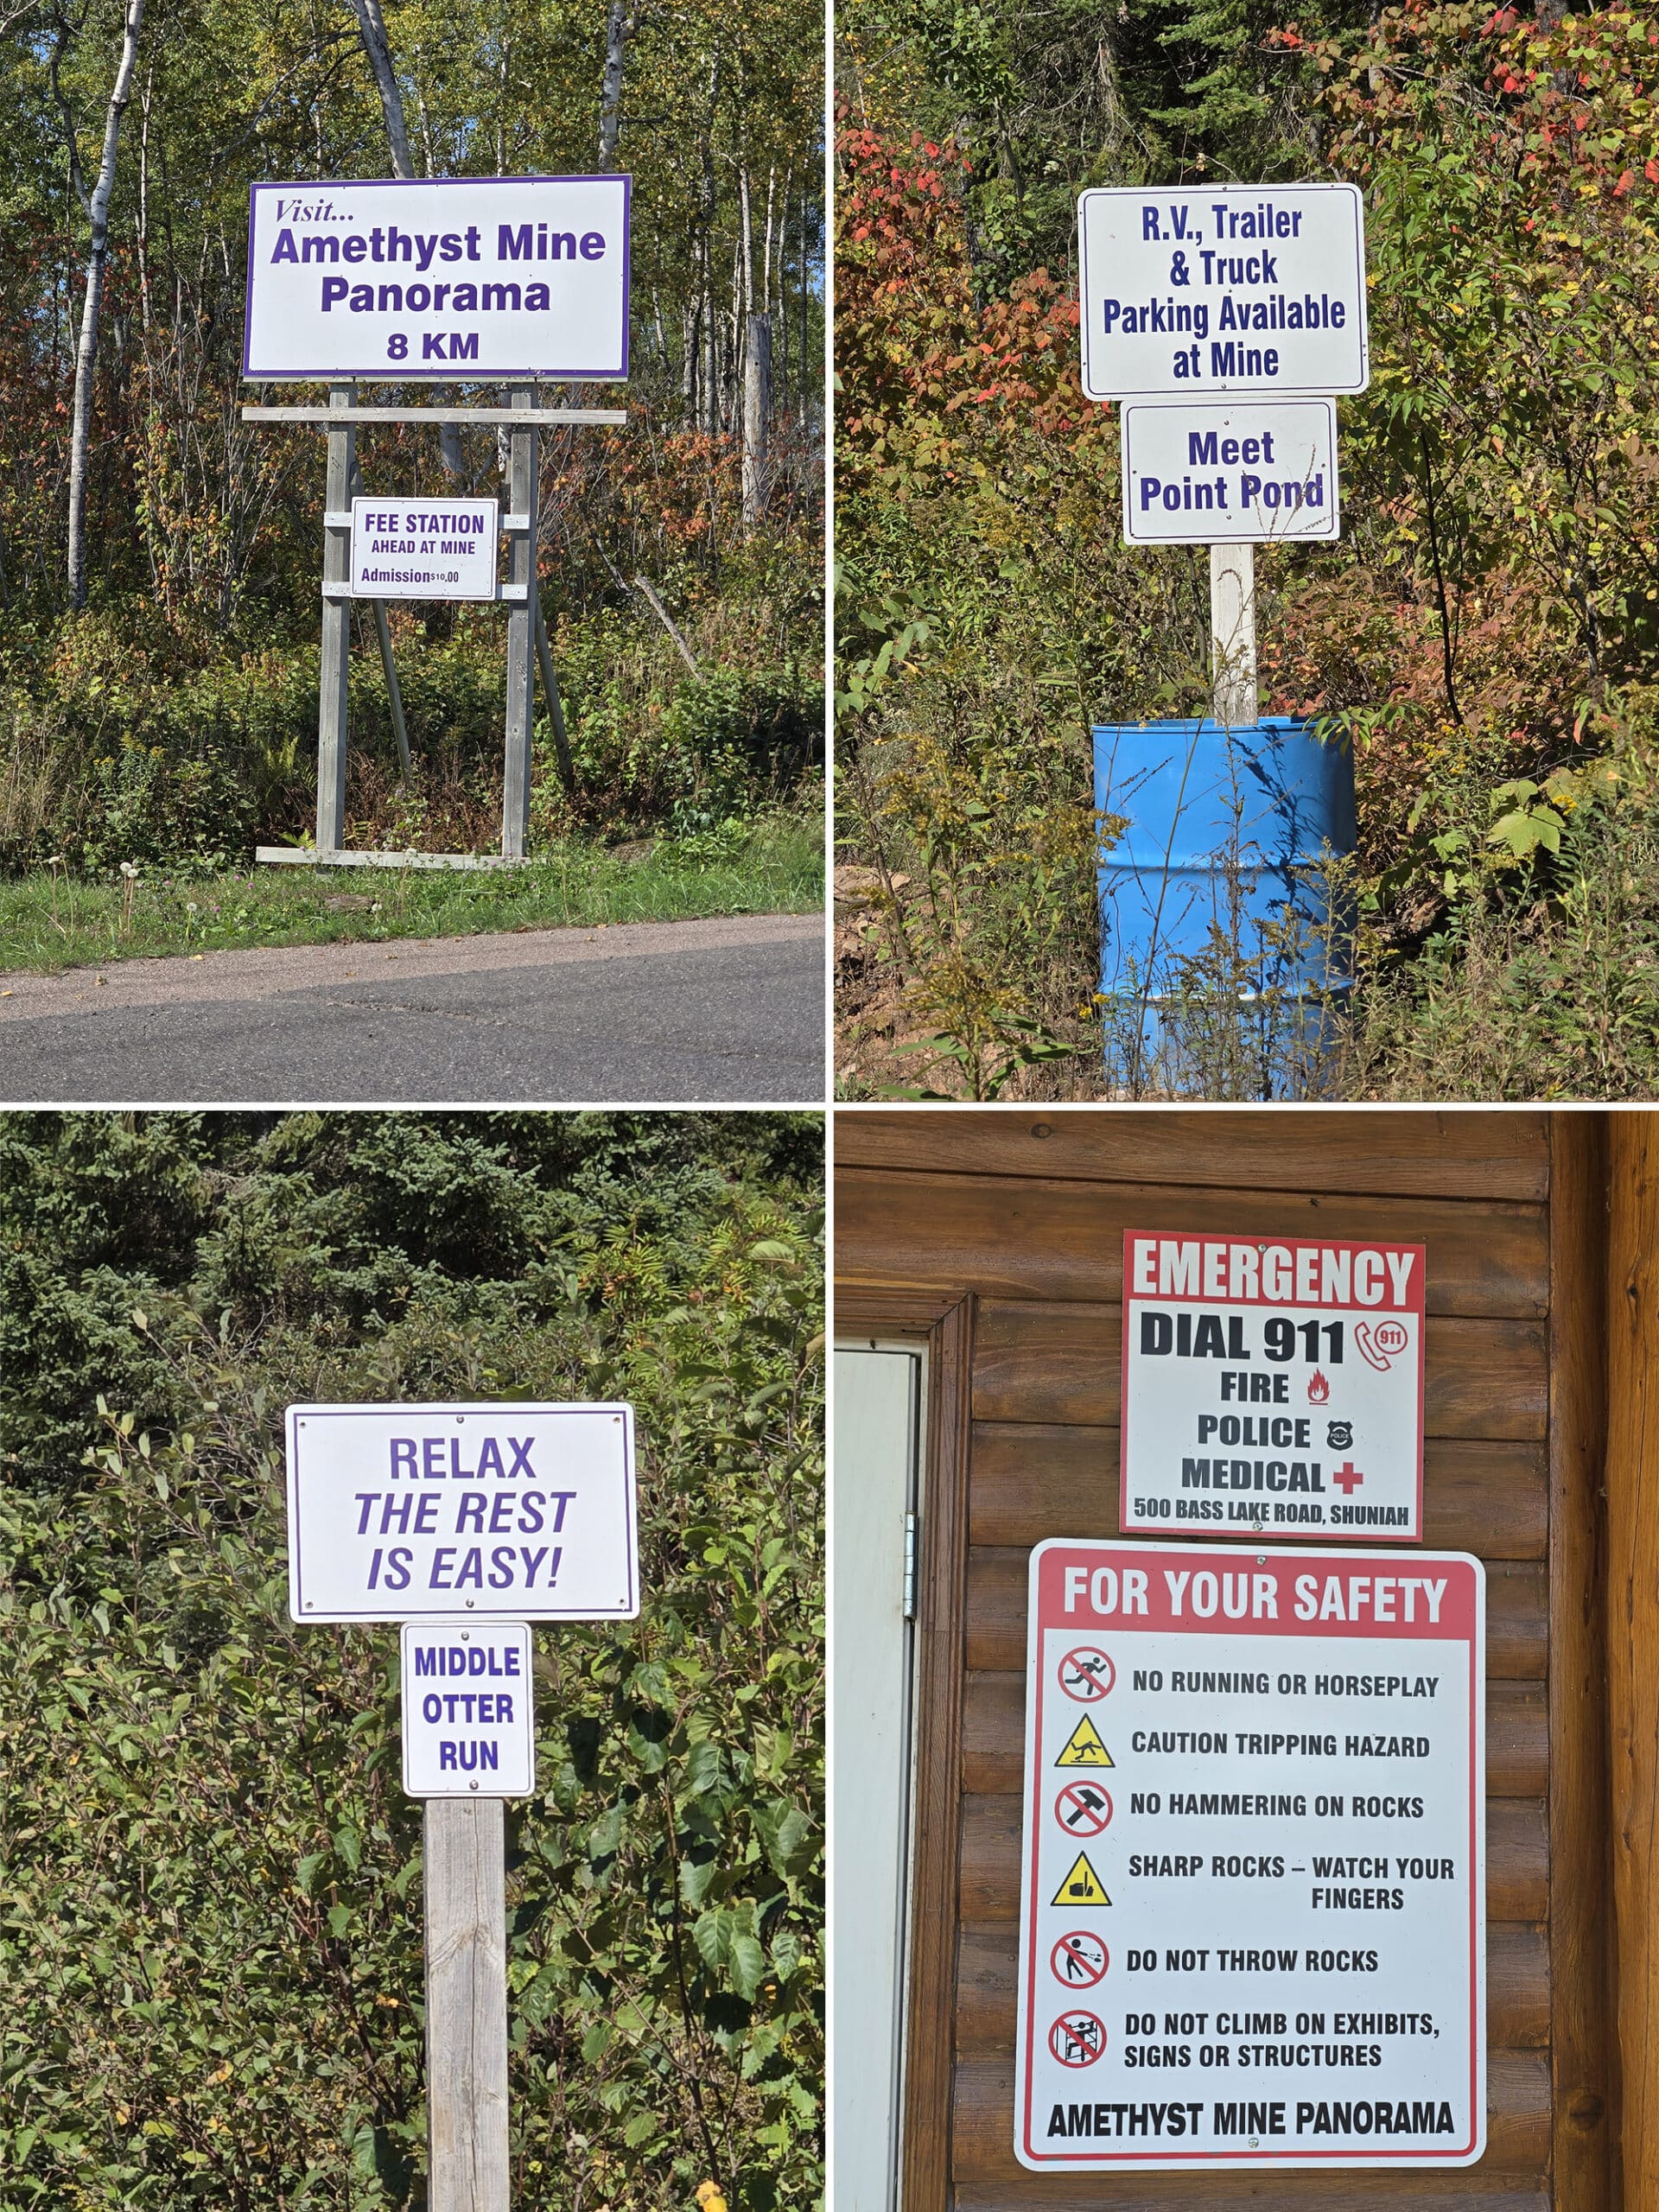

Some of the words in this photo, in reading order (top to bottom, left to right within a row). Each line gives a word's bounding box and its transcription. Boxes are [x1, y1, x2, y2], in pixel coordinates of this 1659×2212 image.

[276, 199, 354, 222] Visit...
[1142, 206, 1203, 245] R.V.,
[1212, 203, 1301, 238] Trailer
[270, 226, 480, 271] Amethyst
[498, 223, 606, 260] Mine
[1170, 251, 1189, 286] &
[1199, 249, 1278, 285] Truck
[321, 276, 550, 312] Panorama
[1103, 296, 1208, 340] Parking
[1219, 294, 1345, 330] Available
[387, 334, 408, 359] 8
[422, 333, 479, 359] KM
[1173, 345, 1200, 378] at
[1211, 342, 1279, 377] Mine
[1188, 431, 1274, 466] Meet
[1141, 477, 1227, 511] Point
[1242, 474, 1323, 509] Pond
[365, 514, 398, 532] FEE
[406, 514, 484, 533] STATION
[372, 540, 415, 553] AHEAD
[420, 541, 435, 554] AT
[441, 542, 475, 554] MINE
[1134, 1239, 1414, 1306] EMERGENCY
[1141, 1312, 1250, 1359] DIAL
[1264, 1318, 1344, 1363] 911
[1379, 1330, 1401, 1344] 911
[1221, 1372, 1289, 1403] FIRE
[1198, 1414, 1310, 1448] POLICE
[390, 1437, 537, 1479] RELAX
[1181, 1459, 1325, 1492] MEDICAL
[354, 1493, 442, 1535] THE
[455, 1491, 576, 1533] REST
[1135, 1498, 1171, 1519] 500
[1176, 1500, 1223, 1521] BASS
[1229, 1502, 1269, 1522] LAKE
[1274, 1503, 1326, 1525] ROAD,
[1331, 1504, 1408, 1525] SHUNIAH
[367, 1548, 413, 1590] IS
[429, 1547, 563, 1589] EASY!
[1065, 1567, 1148, 1615] FOR
[1163, 1570, 1278, 1620] YOUR
[1294, 1574, 1447, 1624] SAFETY
[415, 1647, 520, 1676] MIDDLE
[1133, 1670, 1163, 1692] NO
[1172, 1671, 1269, 1694] RUNNING
[1277, 1674, 1306, 1695] OR
[1315, 1675, 1439, 1698] HORSEPLAY
[423, 1694, 513, 1724] OTTER
[440, 1741, 499, 1770] RUN
[1132, 1732, 1228, 1754] CAUTION
[1236, 1733, 1337, 1756] TRIPPING
[1345, 1735, 1430, 1758] HAZARD
[1130, 1794, 1160, 1815] NO
[1169, 1794, 1306, 1816] HAMMERING
[1314, 1796, 1344, 1816] ON
[1352, 1796, 1424, 1818] ROCKS
[1129, 1855, 1203, 1878] SHARP
[1211, 1856, 1285, 1878] ROCKS
[1313, 1857, 1388, 1878] WATCH
[1396, 1858, 1454, 1879] YOUR
[1312, 1888, 1404, 1910] FINGERS
[1127, 1950, 1157, 1971] DO
[1166, 1950, 1210, 1971] NOT
[1217, 1950, 1298, 1972] THROW
[1306, 1950, 1378, 1972] ROCKS
[1126, 2013, 1156, 2035] DO
[1165, 2013, 1209, 2035] NOT
[1217, 2013, 1287, 2035] CLIMB
[1295, 2013, 1325, 2035] ON
[1334, 2013, 1440, 2038] EXHIBITS,
[1125, 2045, 1192, 2068] SIGNS
[1199, 2045, 1230, 2067] OR
[1237, 2044, 1382, 2067] STRUCTURES
[1047, 2102, 1204, 2138] AMETHYST
[1214, 2101, 1286, 2135] MINE
[1296, 2101, 1454, 2134] PANORAMA
